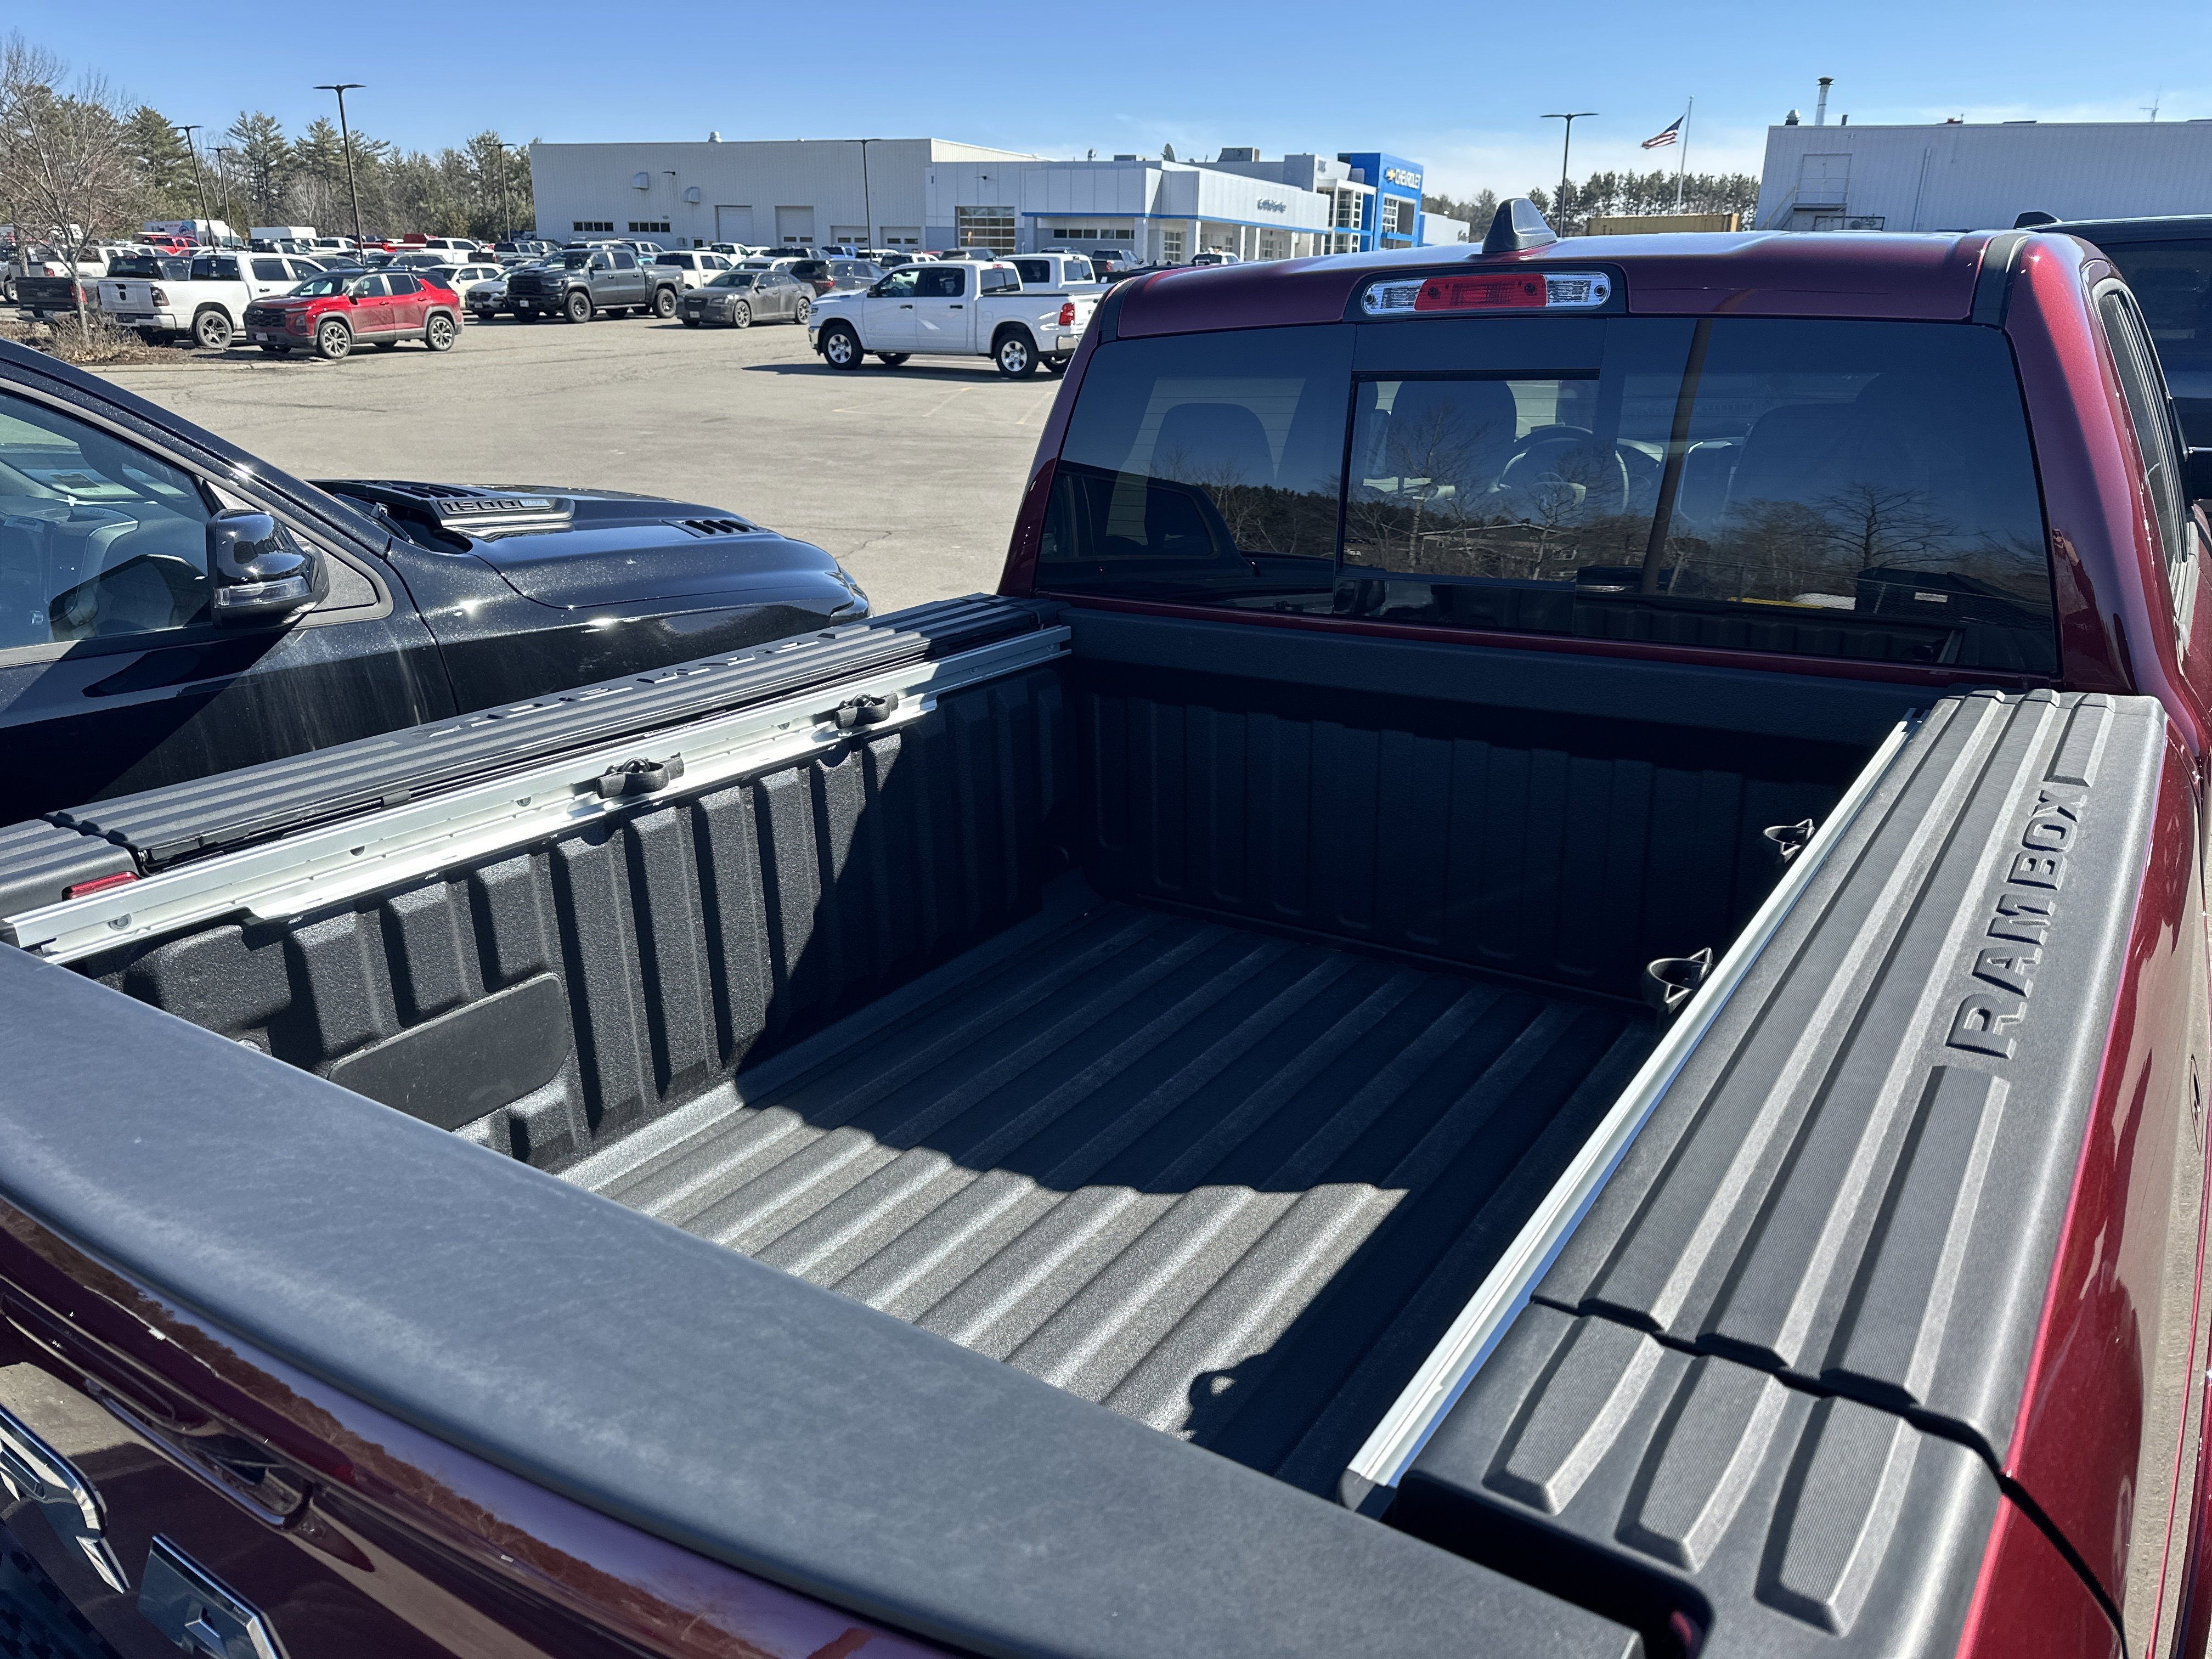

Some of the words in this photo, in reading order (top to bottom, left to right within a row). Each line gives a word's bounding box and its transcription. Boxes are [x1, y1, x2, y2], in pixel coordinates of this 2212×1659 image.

[1395, 168, 1421, 189] CHEVROLET
[443, 499, 520, 511] 1500
[1945, 789, 2087, 1060] RAMBOX
